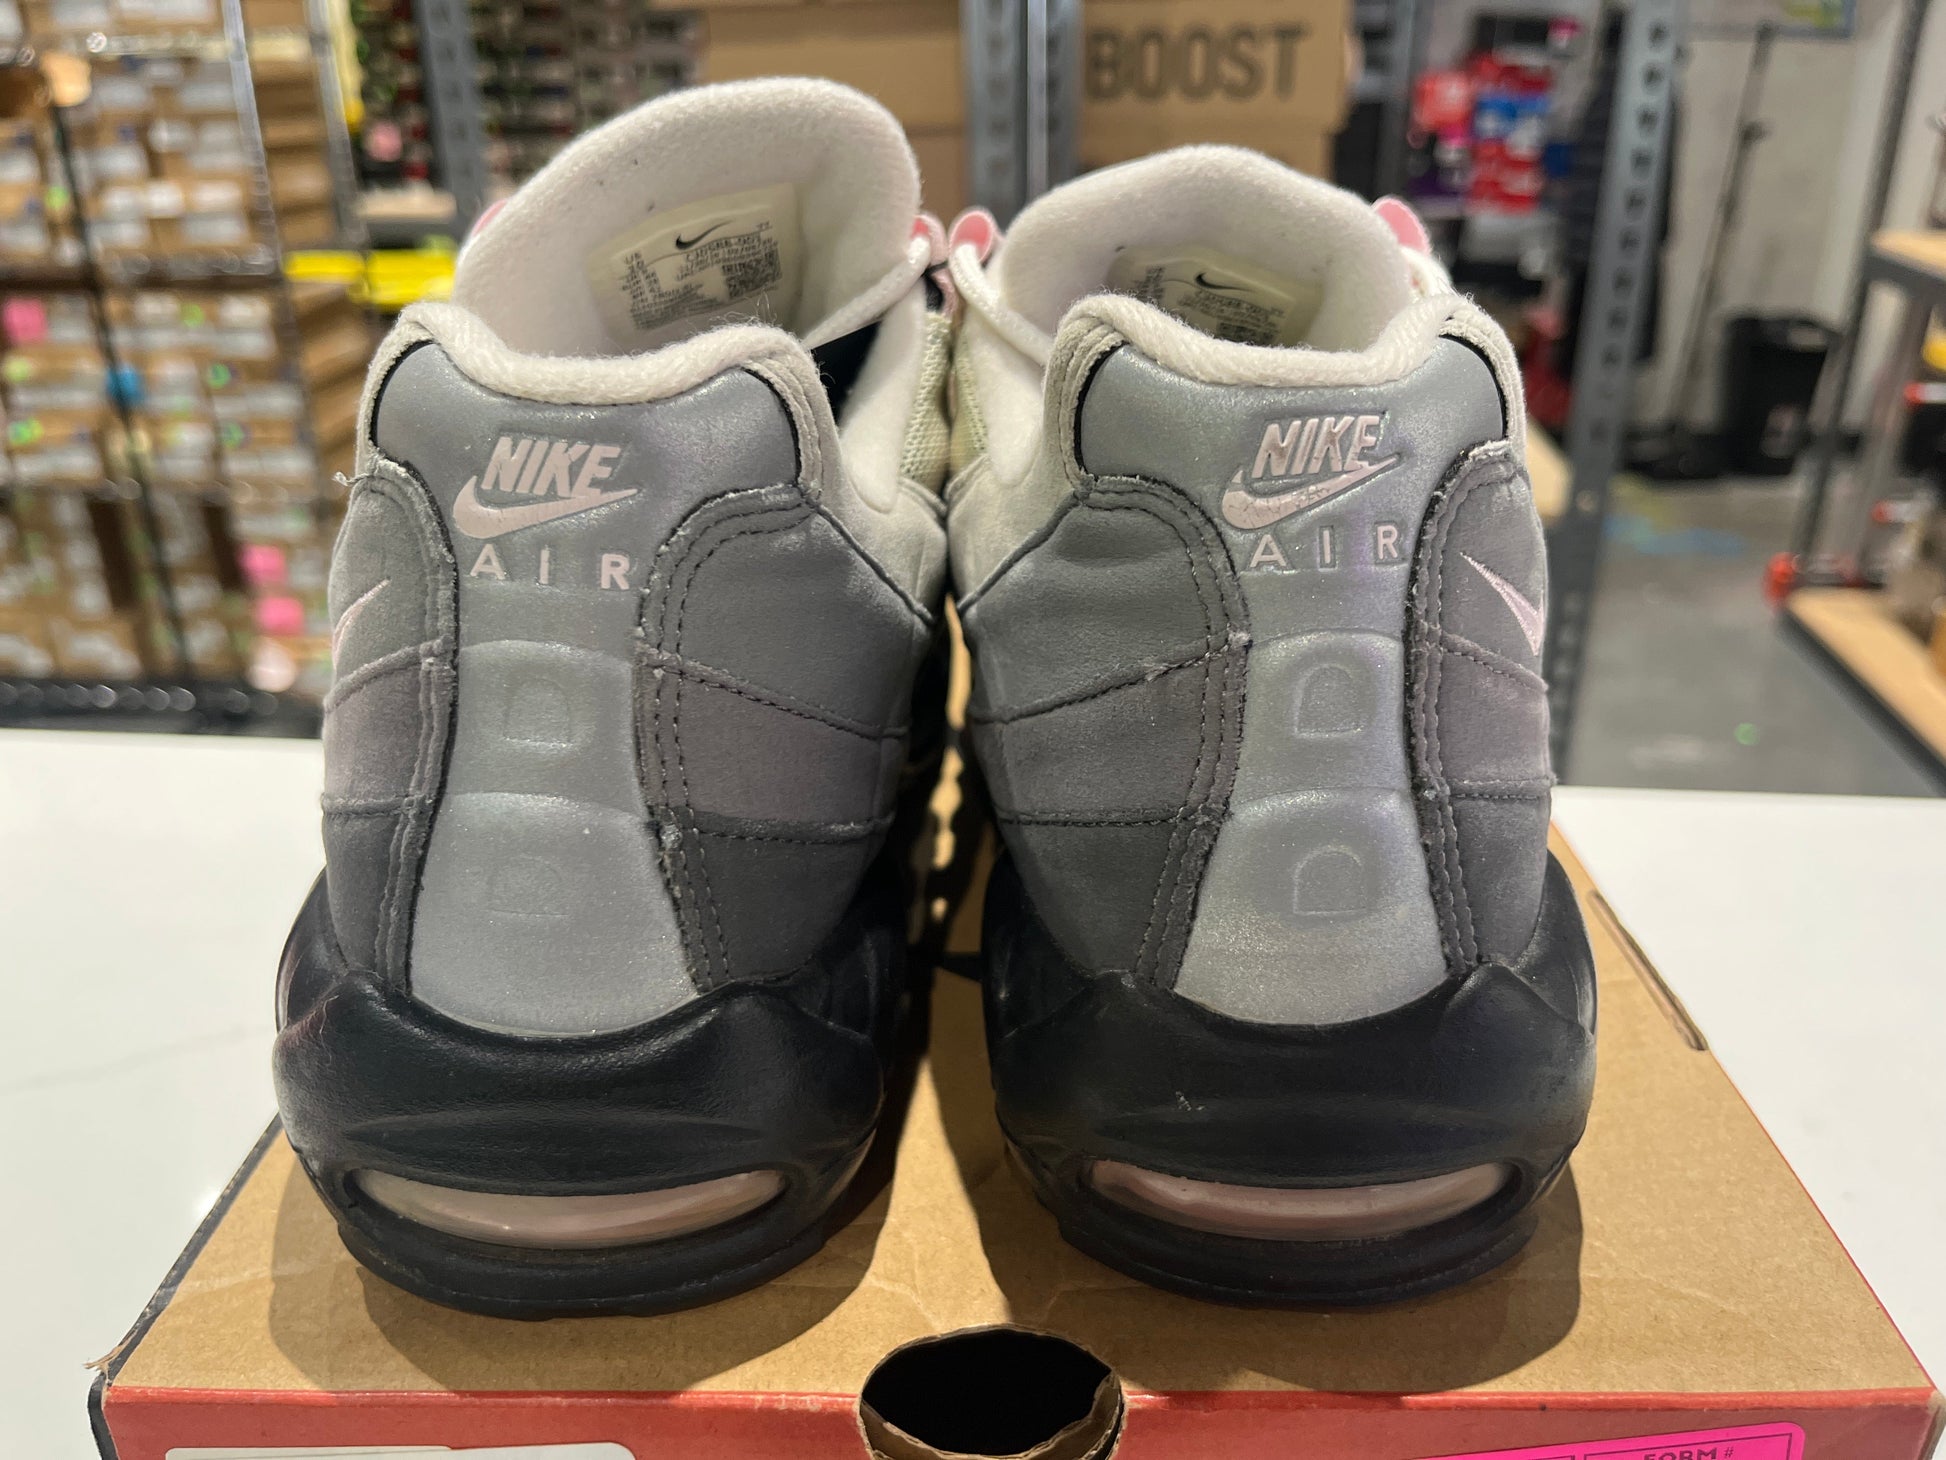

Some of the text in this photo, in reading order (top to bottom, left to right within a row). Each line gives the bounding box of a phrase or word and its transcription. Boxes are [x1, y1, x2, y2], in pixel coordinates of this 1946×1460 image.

[1086, 24, 1309, 101] BOOST
[481, 436, 621, 498] NIKE
[1252, 415, 1379, 478] NIKE
[470, 543, 629, 590] AIR
[1250, 525, 1398, 567] AIR
